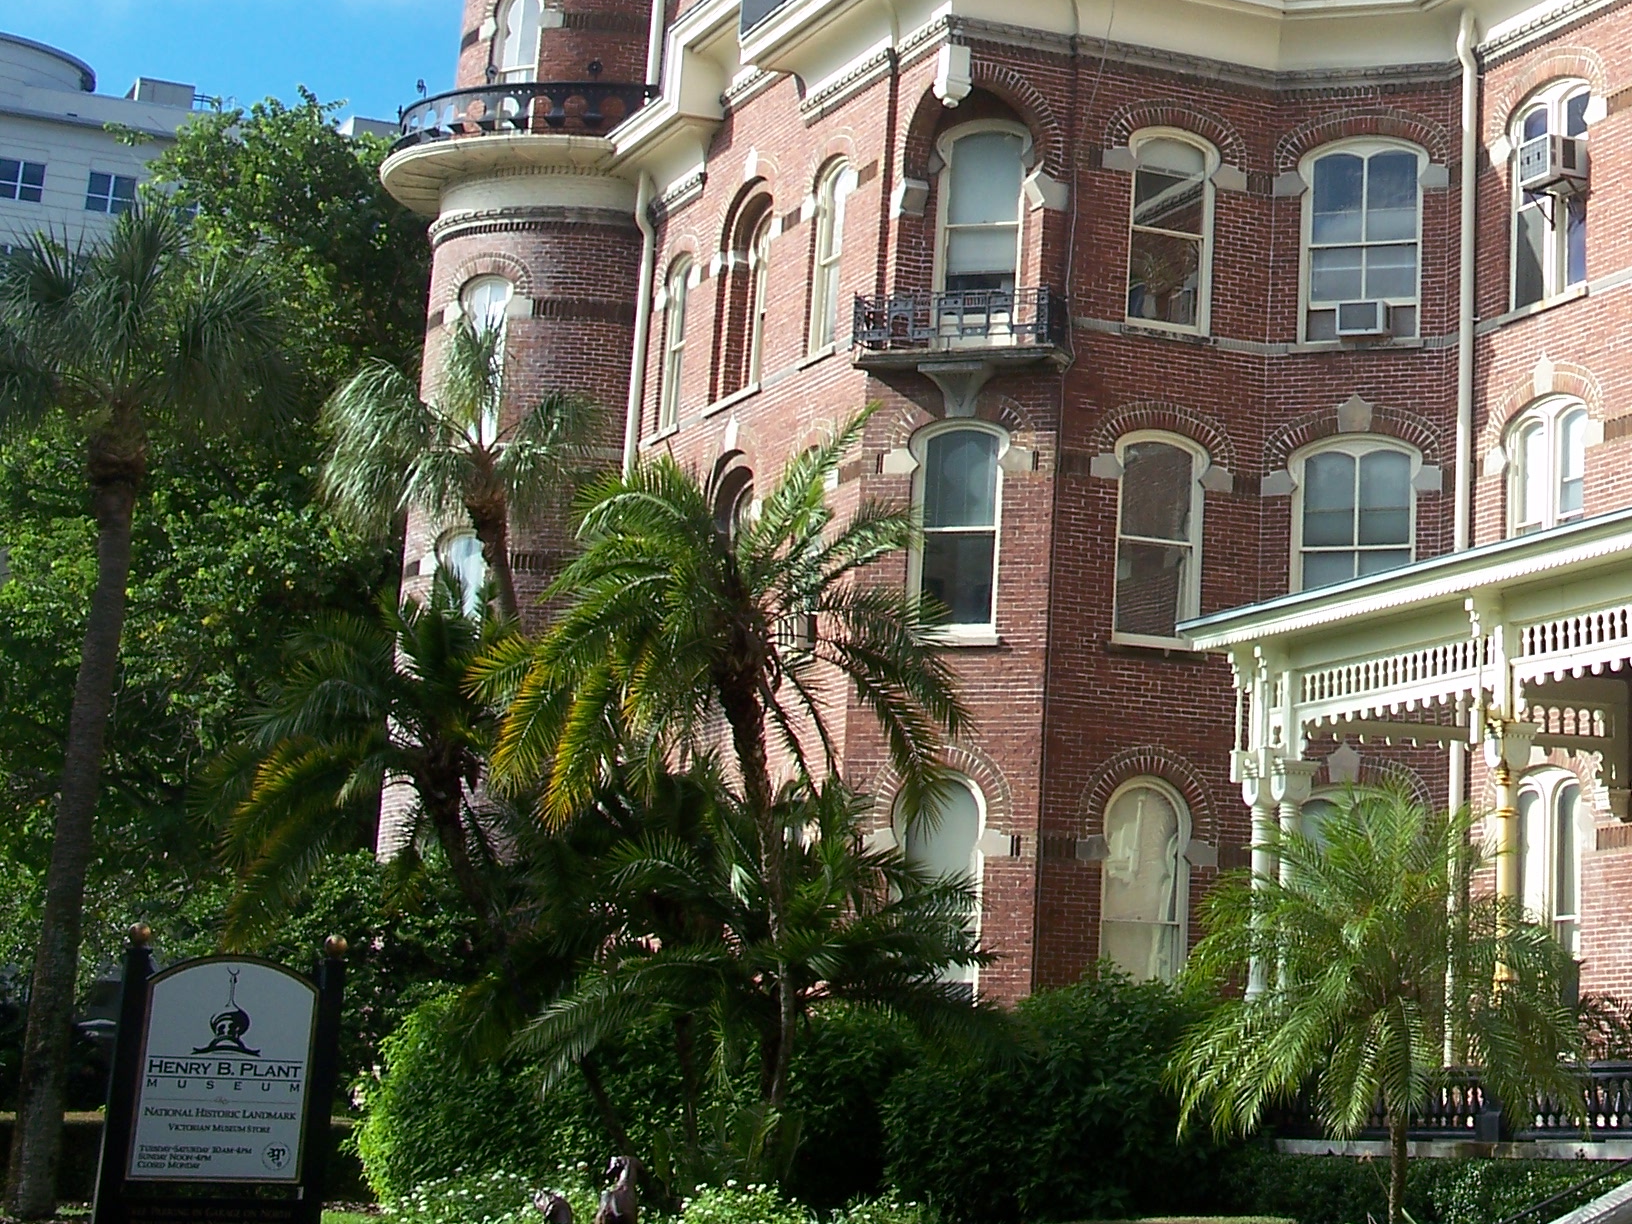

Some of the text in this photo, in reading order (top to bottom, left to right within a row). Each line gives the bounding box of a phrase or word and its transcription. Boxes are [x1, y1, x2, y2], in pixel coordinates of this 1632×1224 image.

[149, 1060, 302, 1078] HENRY B. PLANT
[146, 1078, 300, 1092] MUSEUM
[144, 1107, 297, 1120] NATIONAL HISTORIC LANDMARK
[168, 1123, 271, 1134] VICTORIAN MUSEUM STORE
[138, 1153, 167, 1161] SUNDAY
[136, 1160, 201, 1169] CLOSED MONDAY
